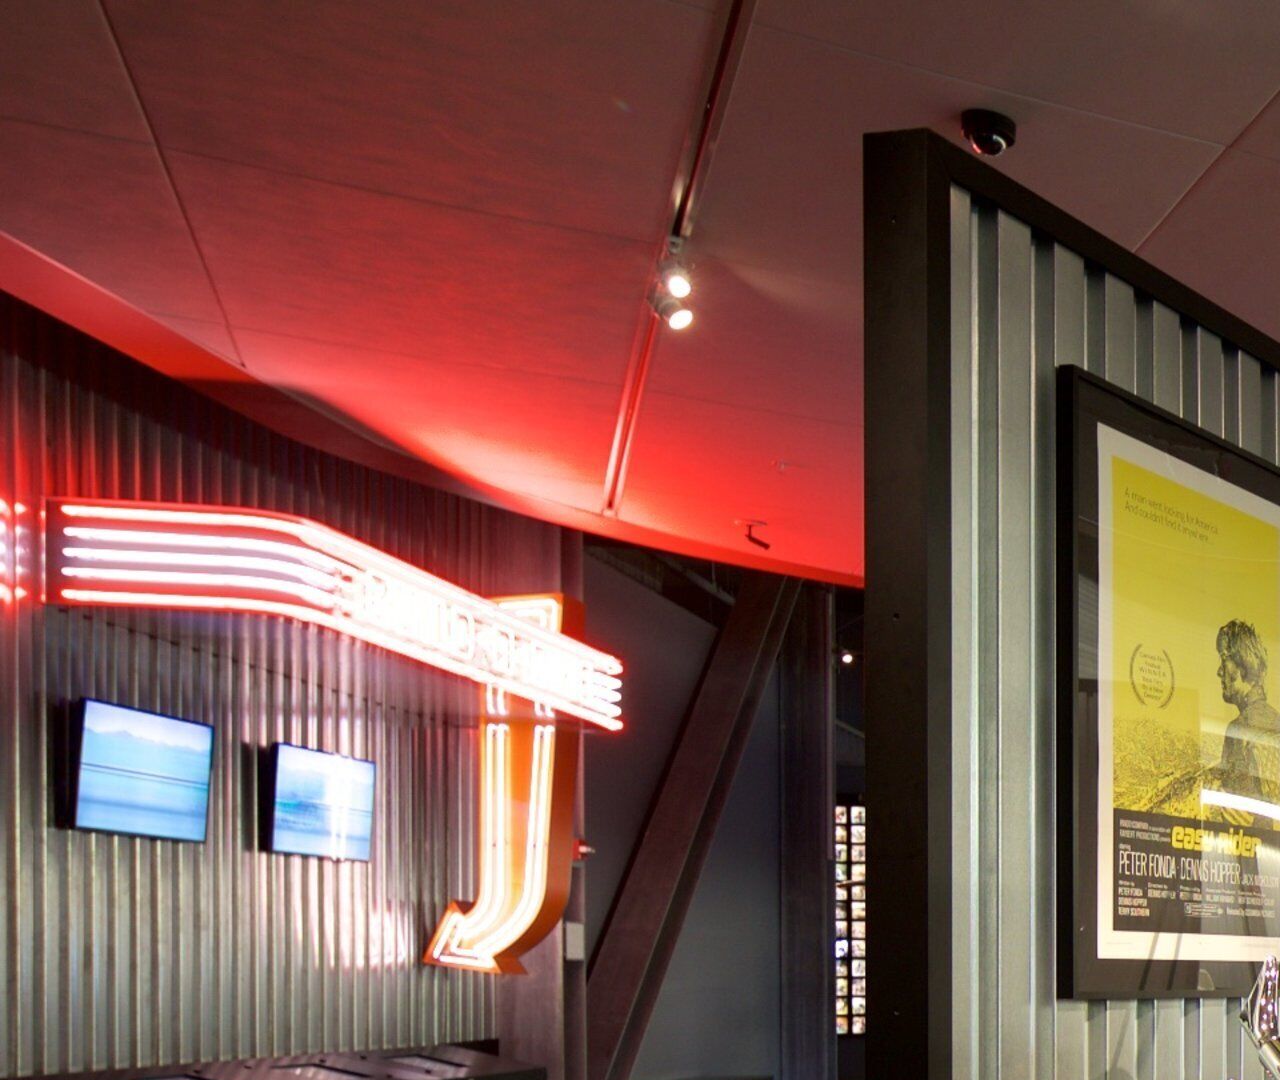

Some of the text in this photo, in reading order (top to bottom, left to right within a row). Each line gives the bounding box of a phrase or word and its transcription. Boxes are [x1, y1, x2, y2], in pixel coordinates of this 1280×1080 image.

[1119, 850, 1147, 876] PETER
[1148, 853, 1177, 879] FONDA
[1180, 856, 1209, 882] DENNIS
[1210, 860, 1241, 886] HOPPER
